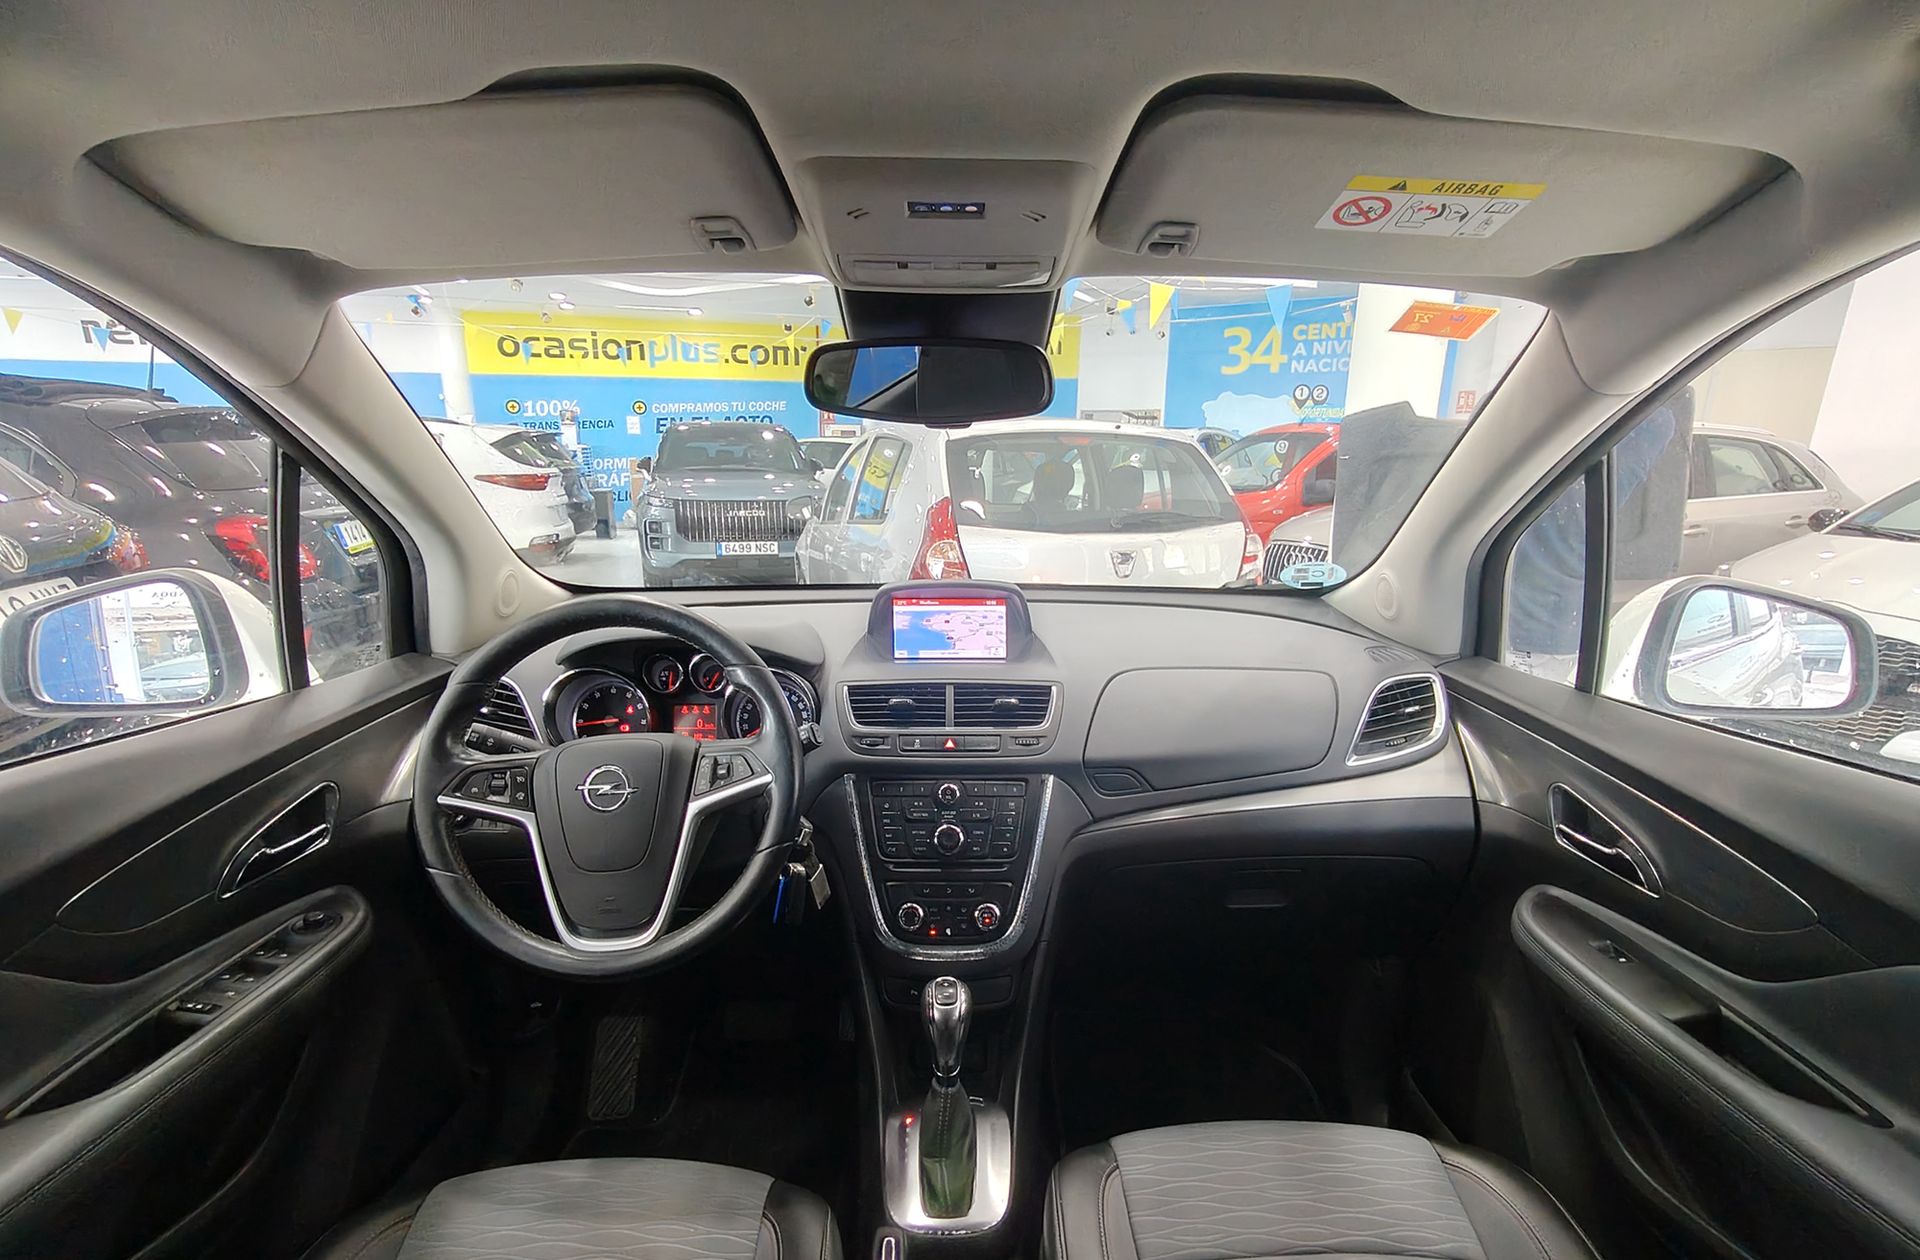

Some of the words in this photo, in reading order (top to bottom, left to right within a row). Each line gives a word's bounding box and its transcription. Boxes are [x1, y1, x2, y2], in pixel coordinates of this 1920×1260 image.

[1431, 182, 1505, 196] AIRBAG
[1293, 321, 1354, 340] CENT
[496, 331, 801, 368] ocasionplus.com
[1221, 325, 1289, 375] 34
[1292, 342, 1307, 356] A
[1312, 340, 1351, 355] NIV
[523, 400, 580, 417] 100%
[652, 402, 731, 414] COMPRAMOS
[732, 401, 746, 412] TU
[749, 401, 787, 411] COCHE
[724, 543, 752, 553] 6499
[755, 543, 776, 553] NSC
